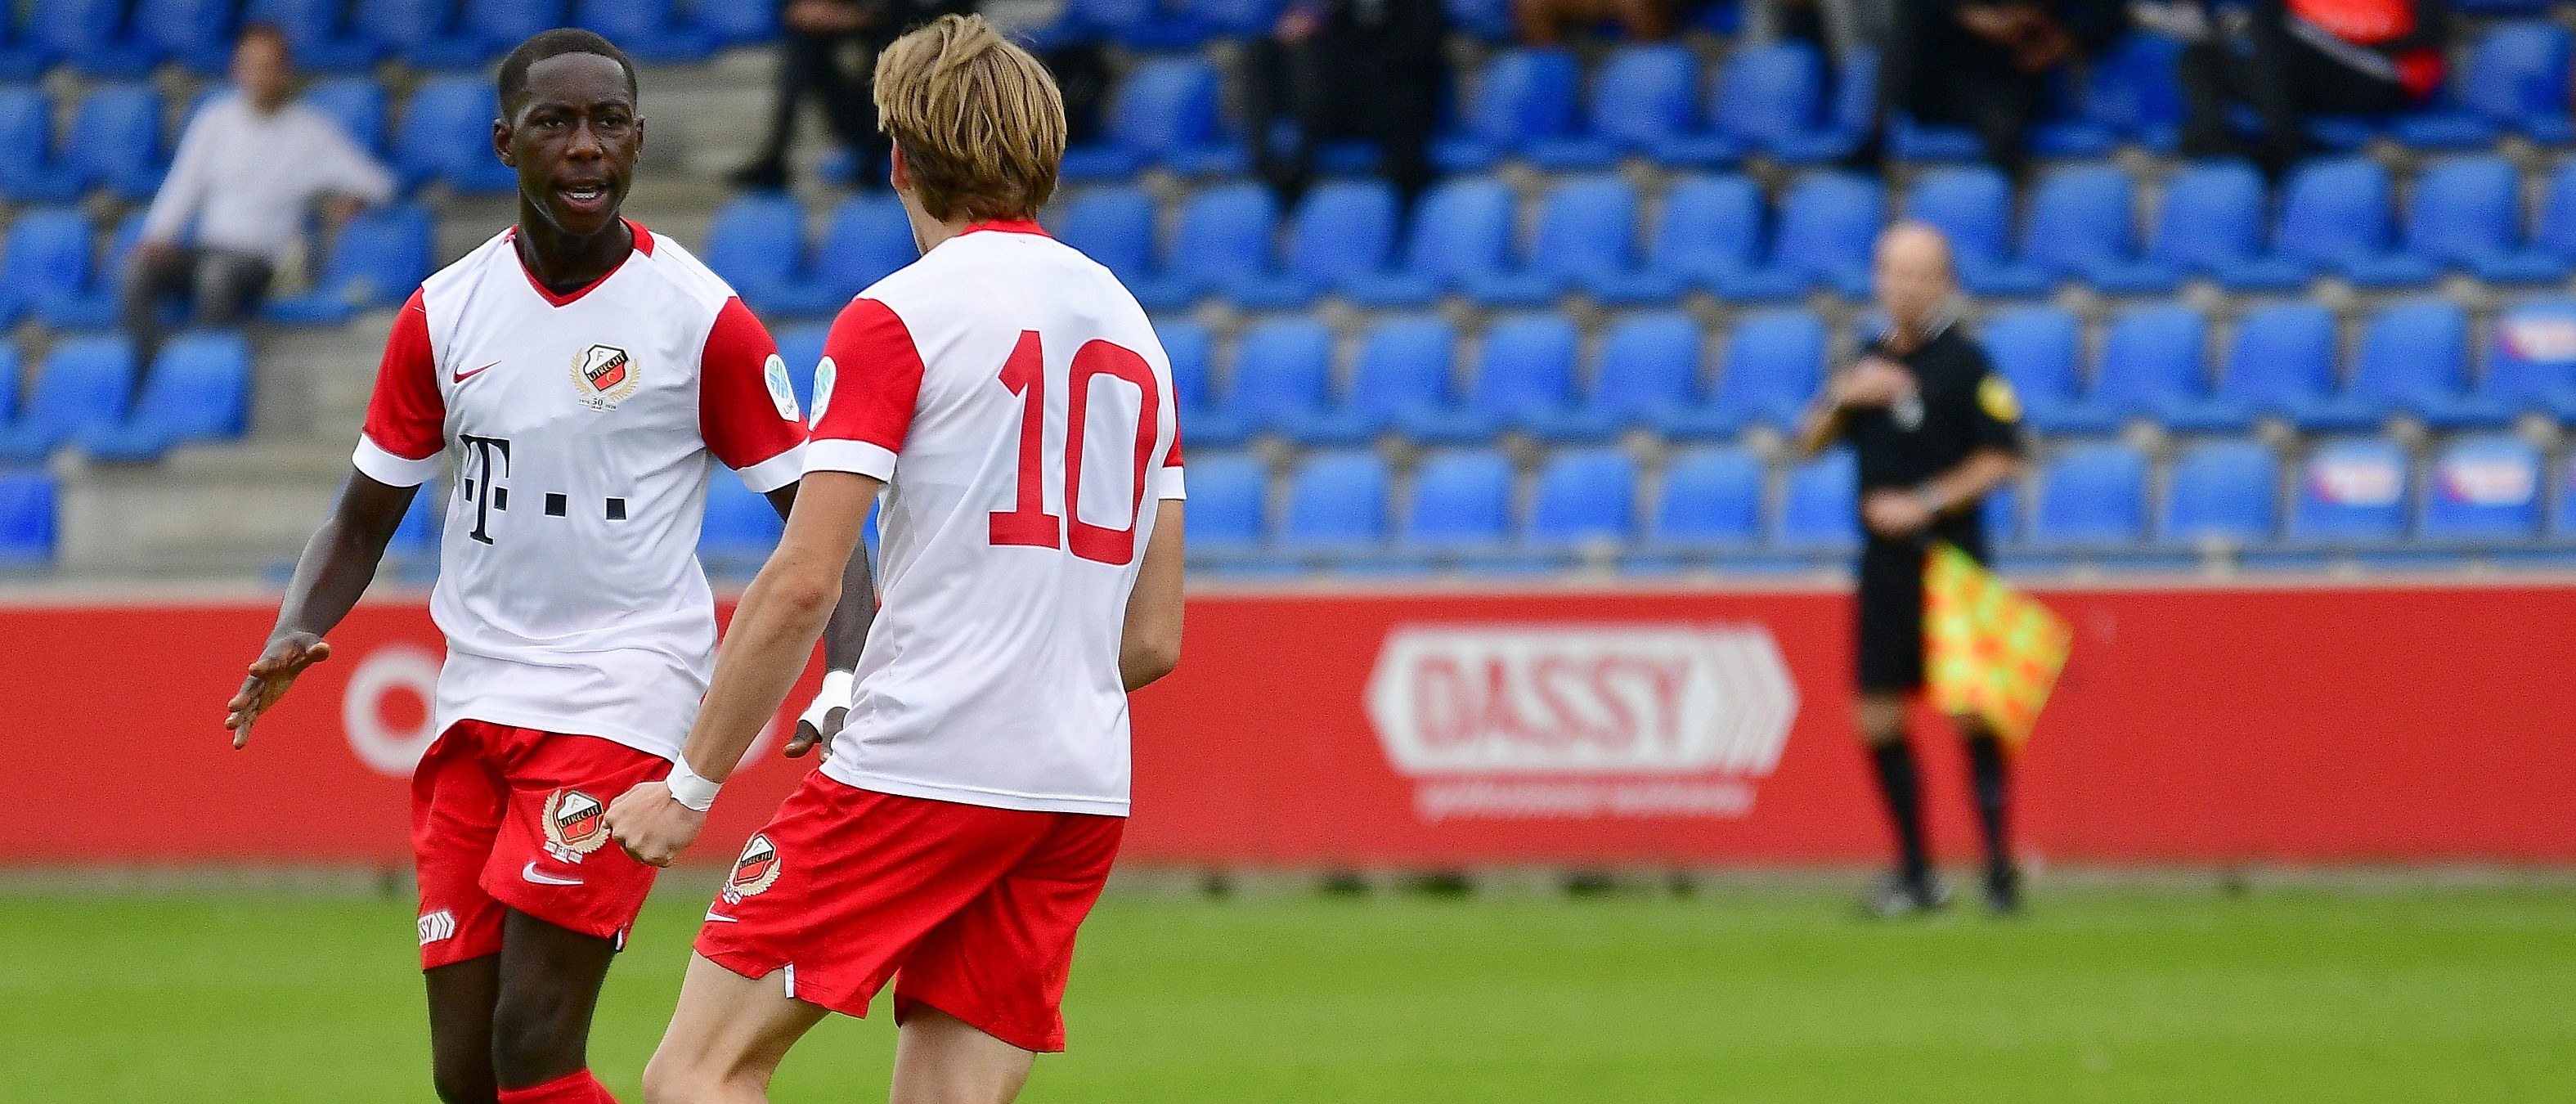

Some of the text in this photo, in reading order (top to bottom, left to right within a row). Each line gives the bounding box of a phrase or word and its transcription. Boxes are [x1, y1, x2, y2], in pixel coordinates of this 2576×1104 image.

[587, 354, 625, 381] UTRECHT
[596, 350, 604, 361] F
[592, 397, 604, 406] 50
[988, 330, 1160, 565] 10
[458, 434, 510, 545] T
[559, 806, 599, 828] UTRECHT
